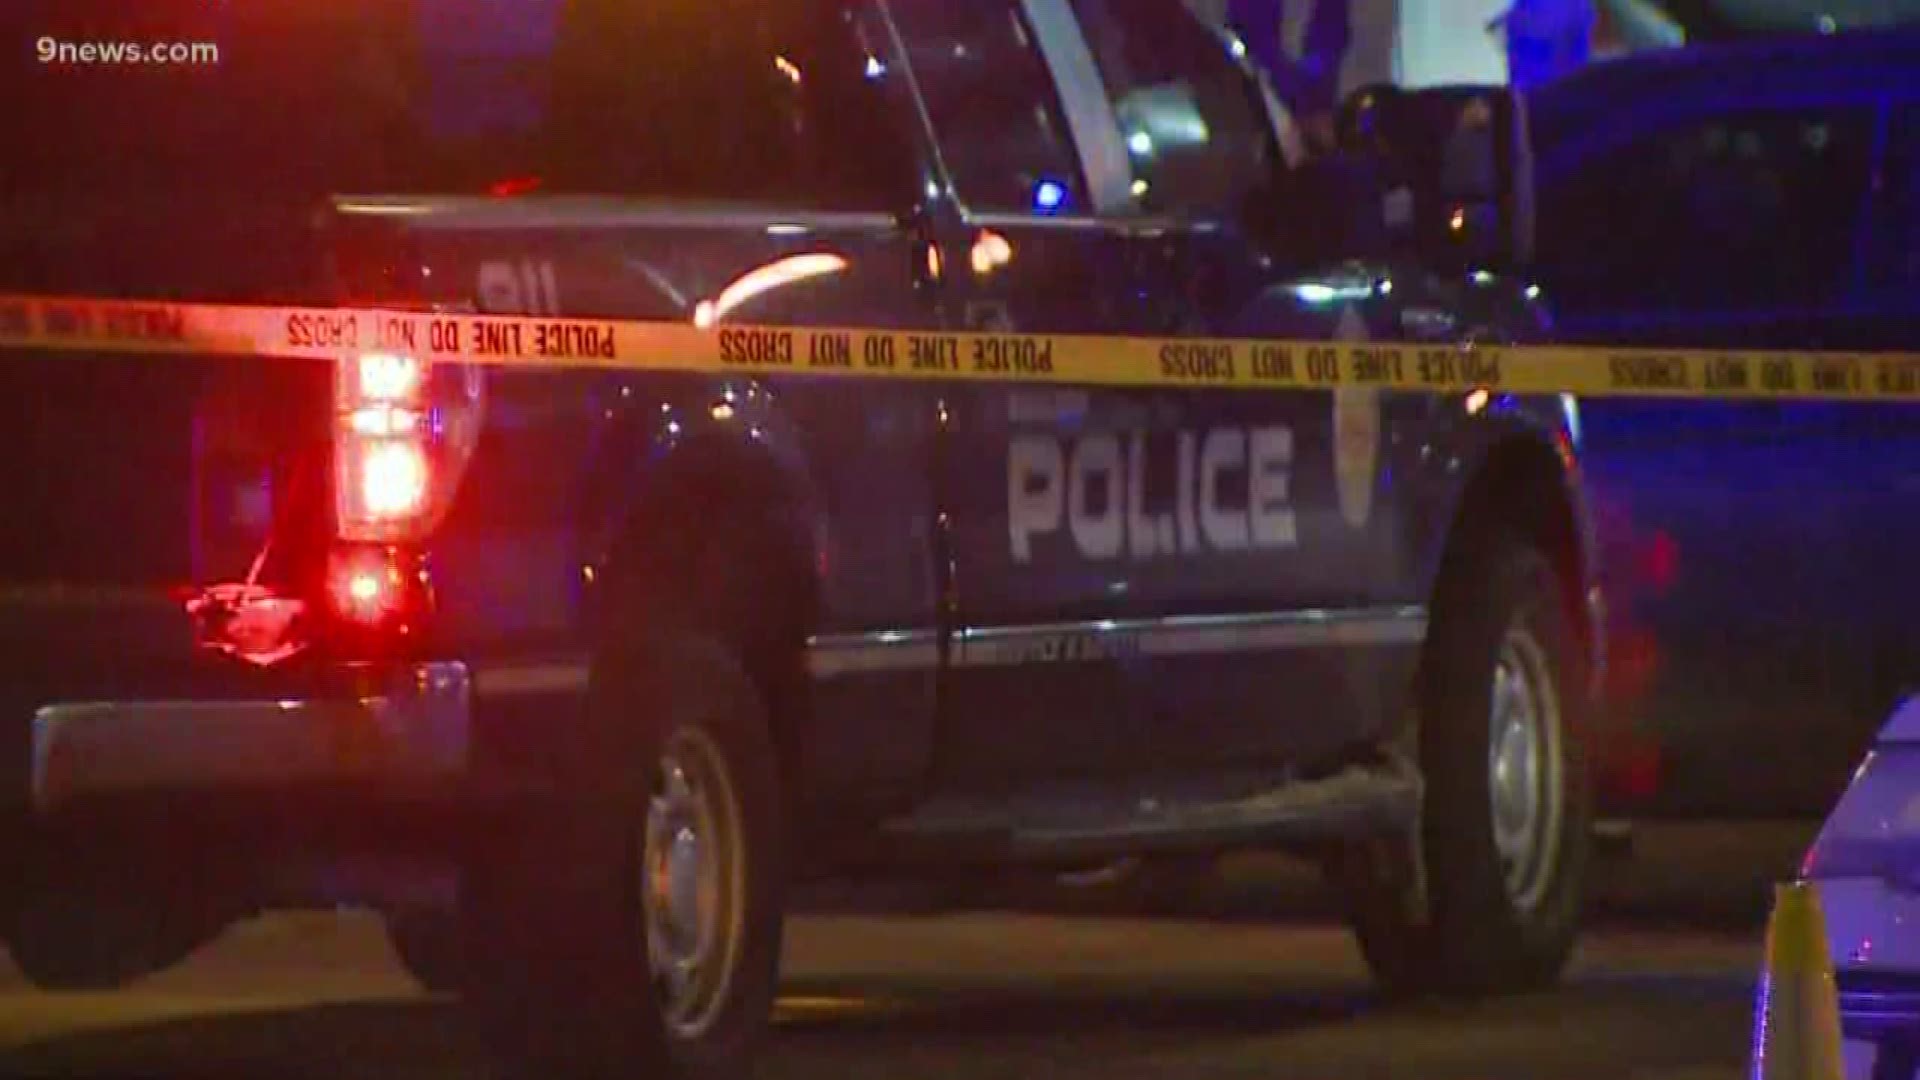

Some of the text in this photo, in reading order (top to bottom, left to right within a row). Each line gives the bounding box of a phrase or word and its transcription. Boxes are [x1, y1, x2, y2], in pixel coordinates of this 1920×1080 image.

[286, 313, 616, 359] POLICE LINE DO NOT CROSS
[718, 328, 1054, 373] POLICE LINE DO NOT CROSS
[1156, 344, 1236, 380] CROSS
[1251, 344, 1295, 379] NOT
[1305, 345, 1340, 381] DO
[1350, 346, 1404, 382] LINE
[1006, 426, 1298, 564] POLICE
